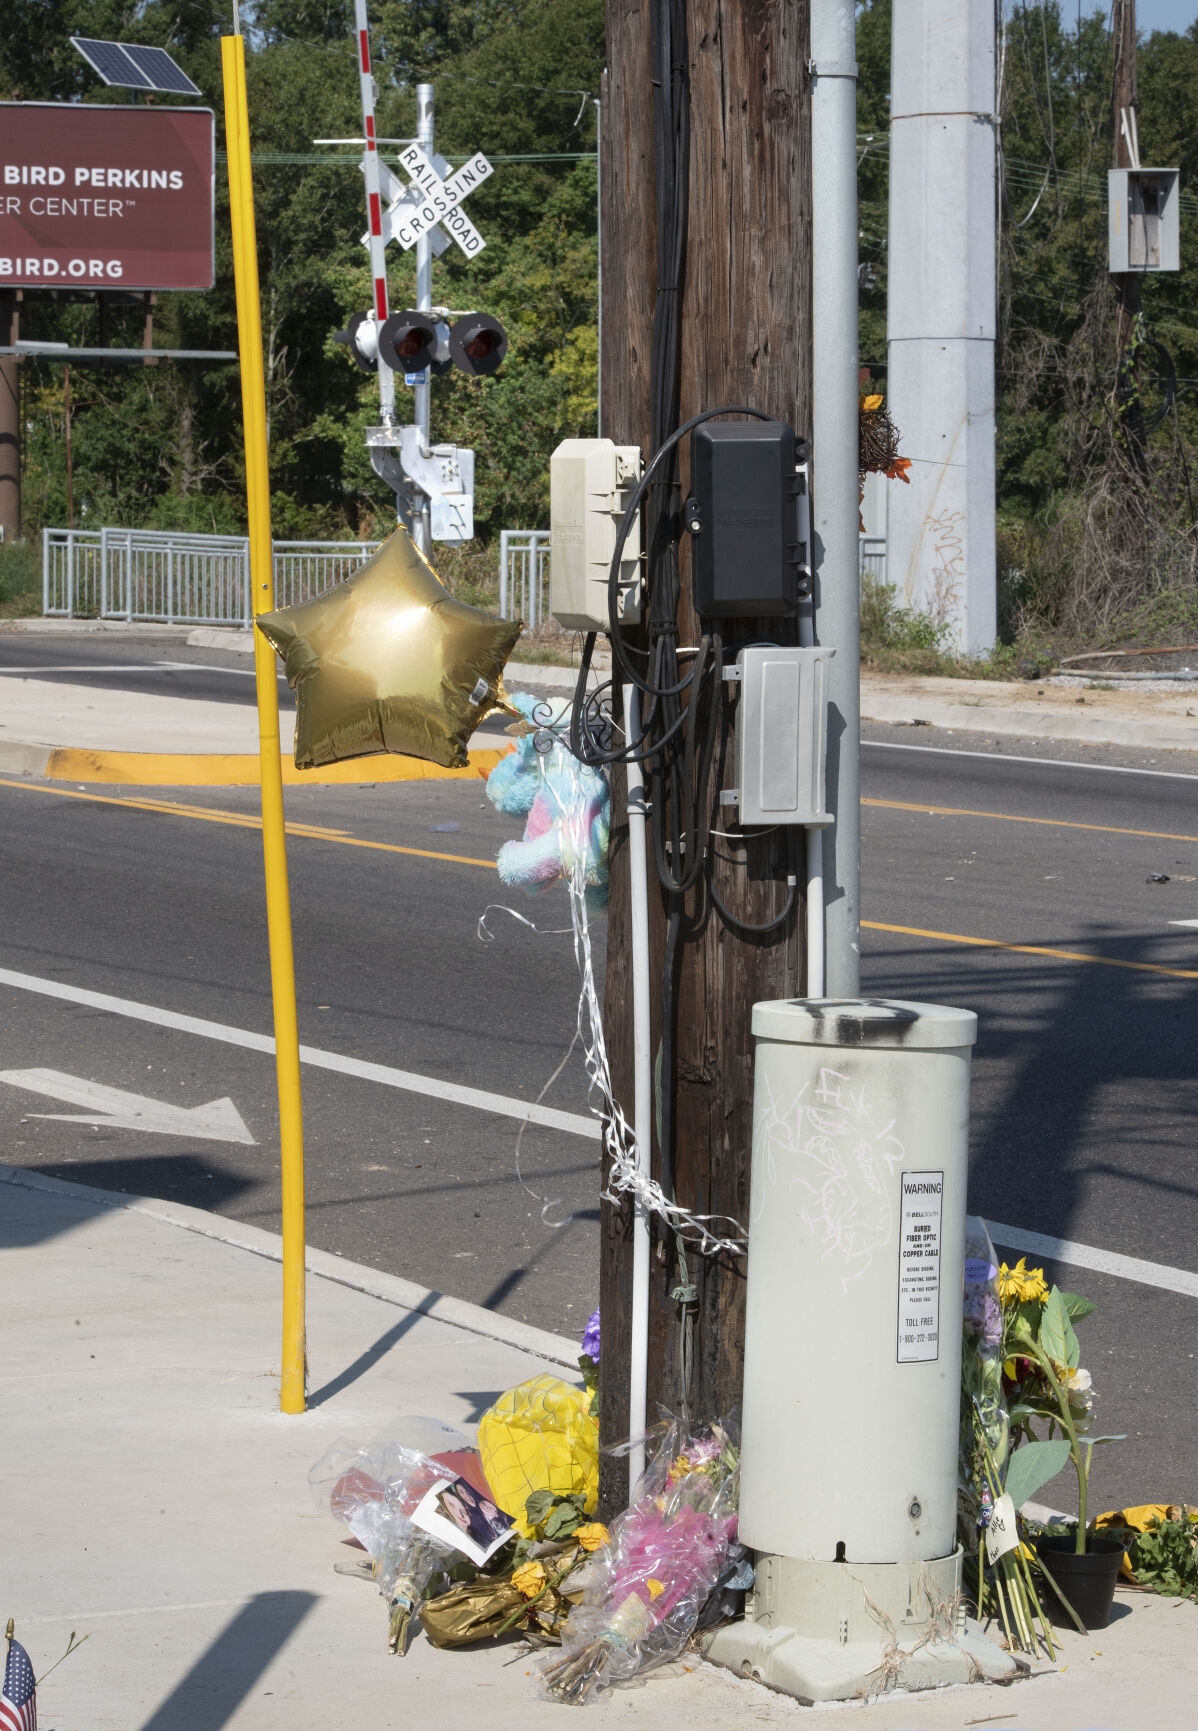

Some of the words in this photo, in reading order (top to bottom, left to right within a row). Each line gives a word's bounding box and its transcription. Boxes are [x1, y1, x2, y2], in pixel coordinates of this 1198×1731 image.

[4, 165, 66, 185] BIRD
[74, 167, 184, 190] PERKINS
[0, 196, 21, 215] R
[399, 160, 488, 243] CROSSING
[403, 149, 437, 195] RAIL
[446, 207, 480, 252] ROAD
[904, 1183, 941, 1194] WARNING
[913, 1225, 931, 1233] BURIED
[906, 1234, 922, 1242] FIBER
[923, 1233, 937, 1242] OPTIC
[902, 1250, 923, 1258] COPPER
[924, 1249, 939, 1257] CABLE
[905, 1318, 919, 1327] TOLL
[920, 1316, 934, 1326] FREE
